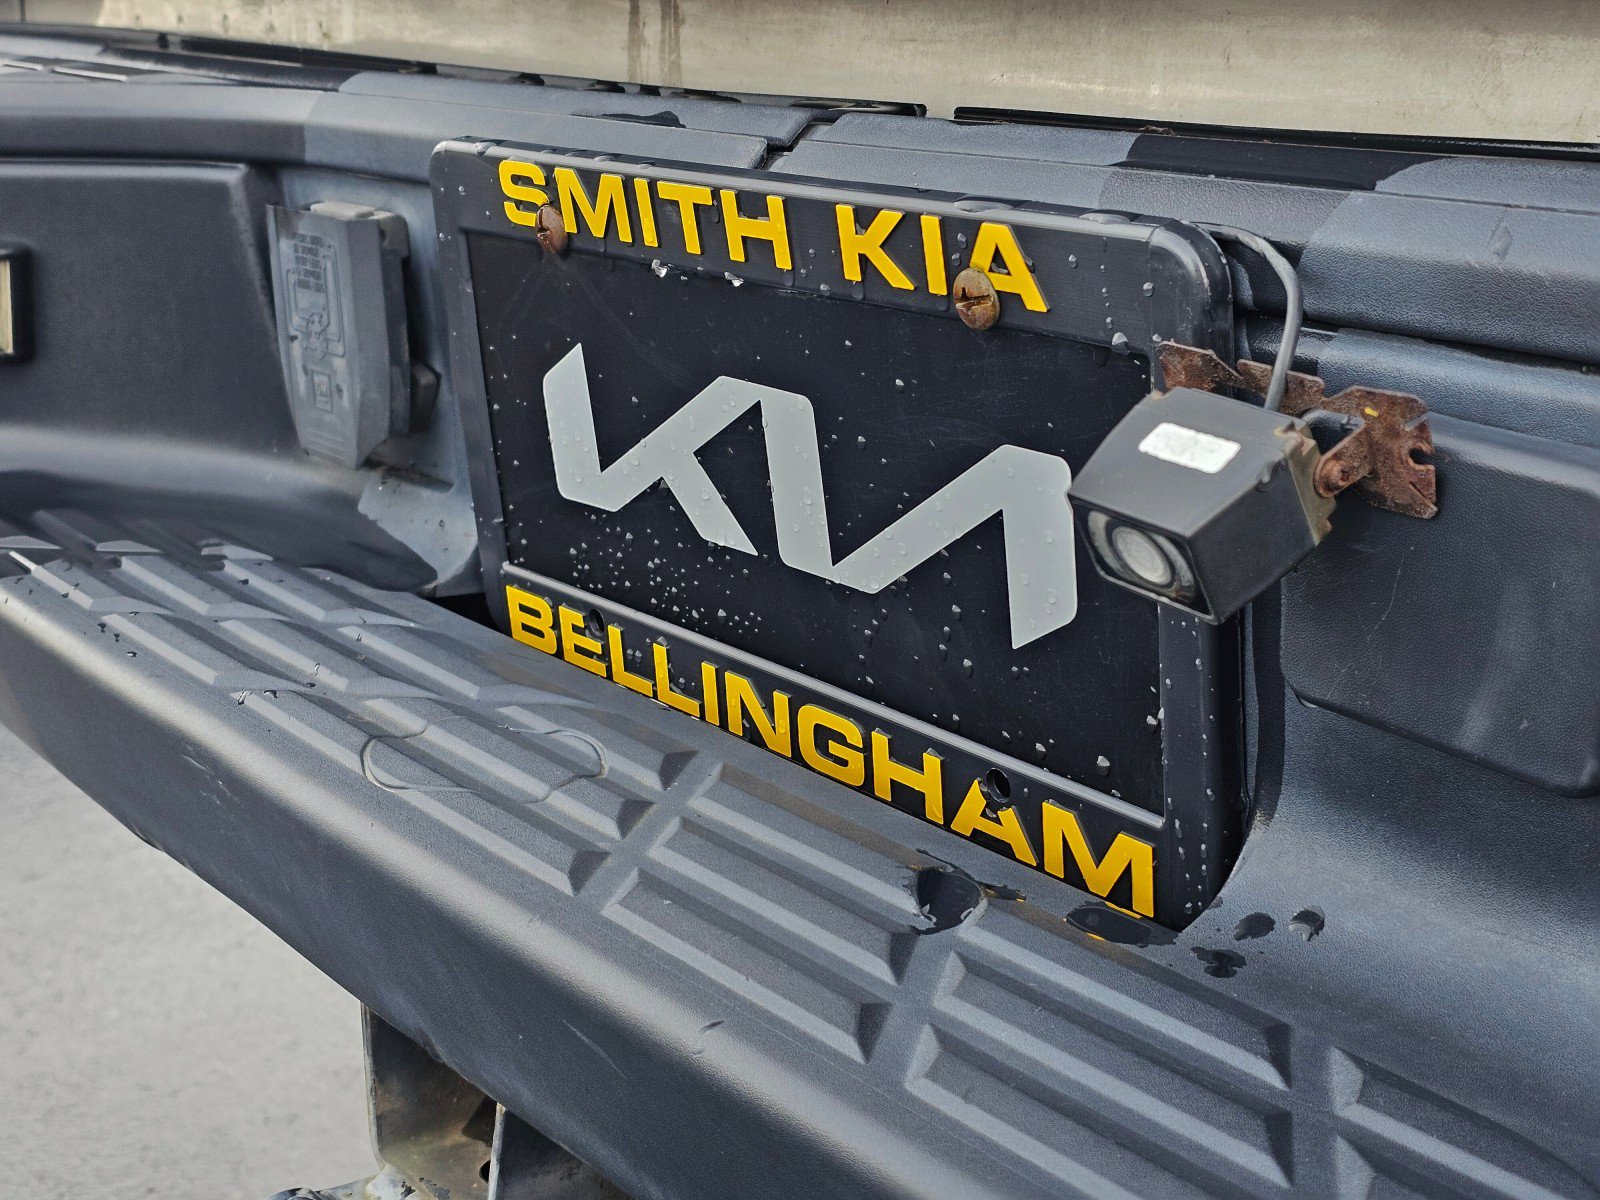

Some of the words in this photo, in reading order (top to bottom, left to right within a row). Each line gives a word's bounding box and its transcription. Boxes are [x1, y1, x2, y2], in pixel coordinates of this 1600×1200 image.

[498, 160, 793, 271] SMITH
[835, 205, 1049, 313] KIA
[506, 584, 1156, 918] BELLINGHAM
